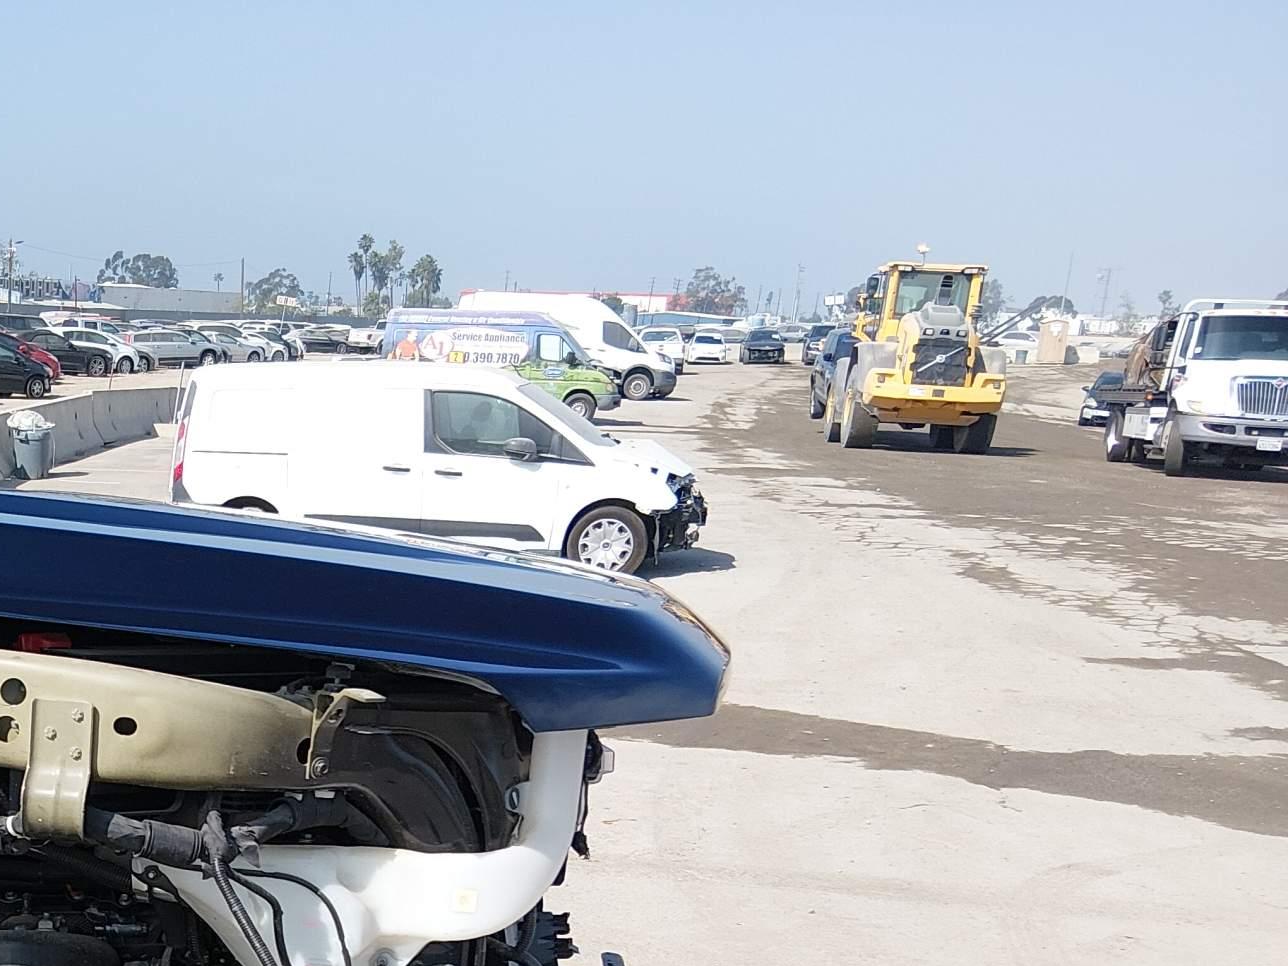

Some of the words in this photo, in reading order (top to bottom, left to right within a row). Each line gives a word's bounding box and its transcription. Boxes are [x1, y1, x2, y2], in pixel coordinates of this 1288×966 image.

[452, 332, 482, 342] Service
[484, 333, 526, 343] Appliance
[463, 351, 521, 364] 0.390.7870
